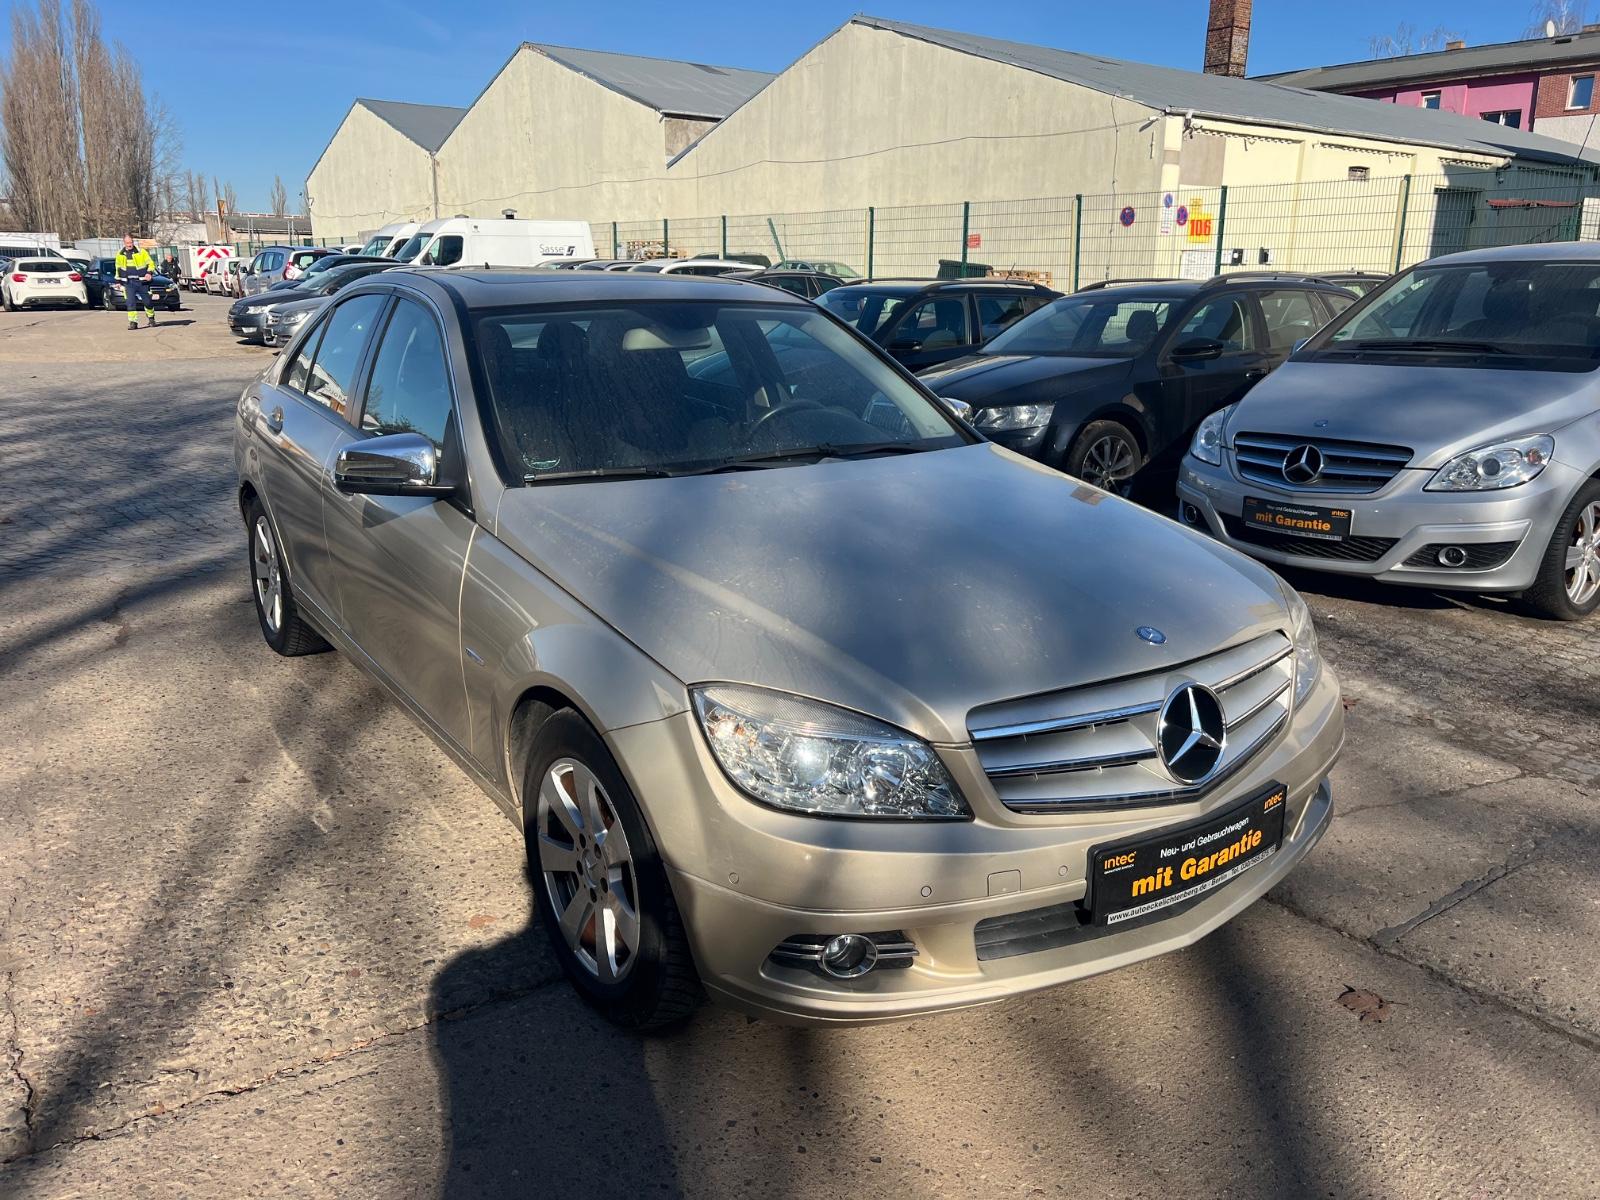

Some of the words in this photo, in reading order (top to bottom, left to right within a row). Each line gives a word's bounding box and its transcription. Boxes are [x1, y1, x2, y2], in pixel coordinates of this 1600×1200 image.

[1190, 219, 1211, 236] 106
[539, 244, 565, 253] Sasse
[1255, 512, 1273, 523] mit
[1275, 514, 1331, 531] Garantie
[1264, 793, 1283, 810] intec
[1160, 847, 1180, 859] Neu-
[1181, 839, 1196, 852] und
[1197, 817, 1250, 847] Gebrauchtwagen
[1104, 851, 1136, 870] intec
[1131, 867, 1174, 898] mit
[1180, 828, 1263, 882] Garantie
